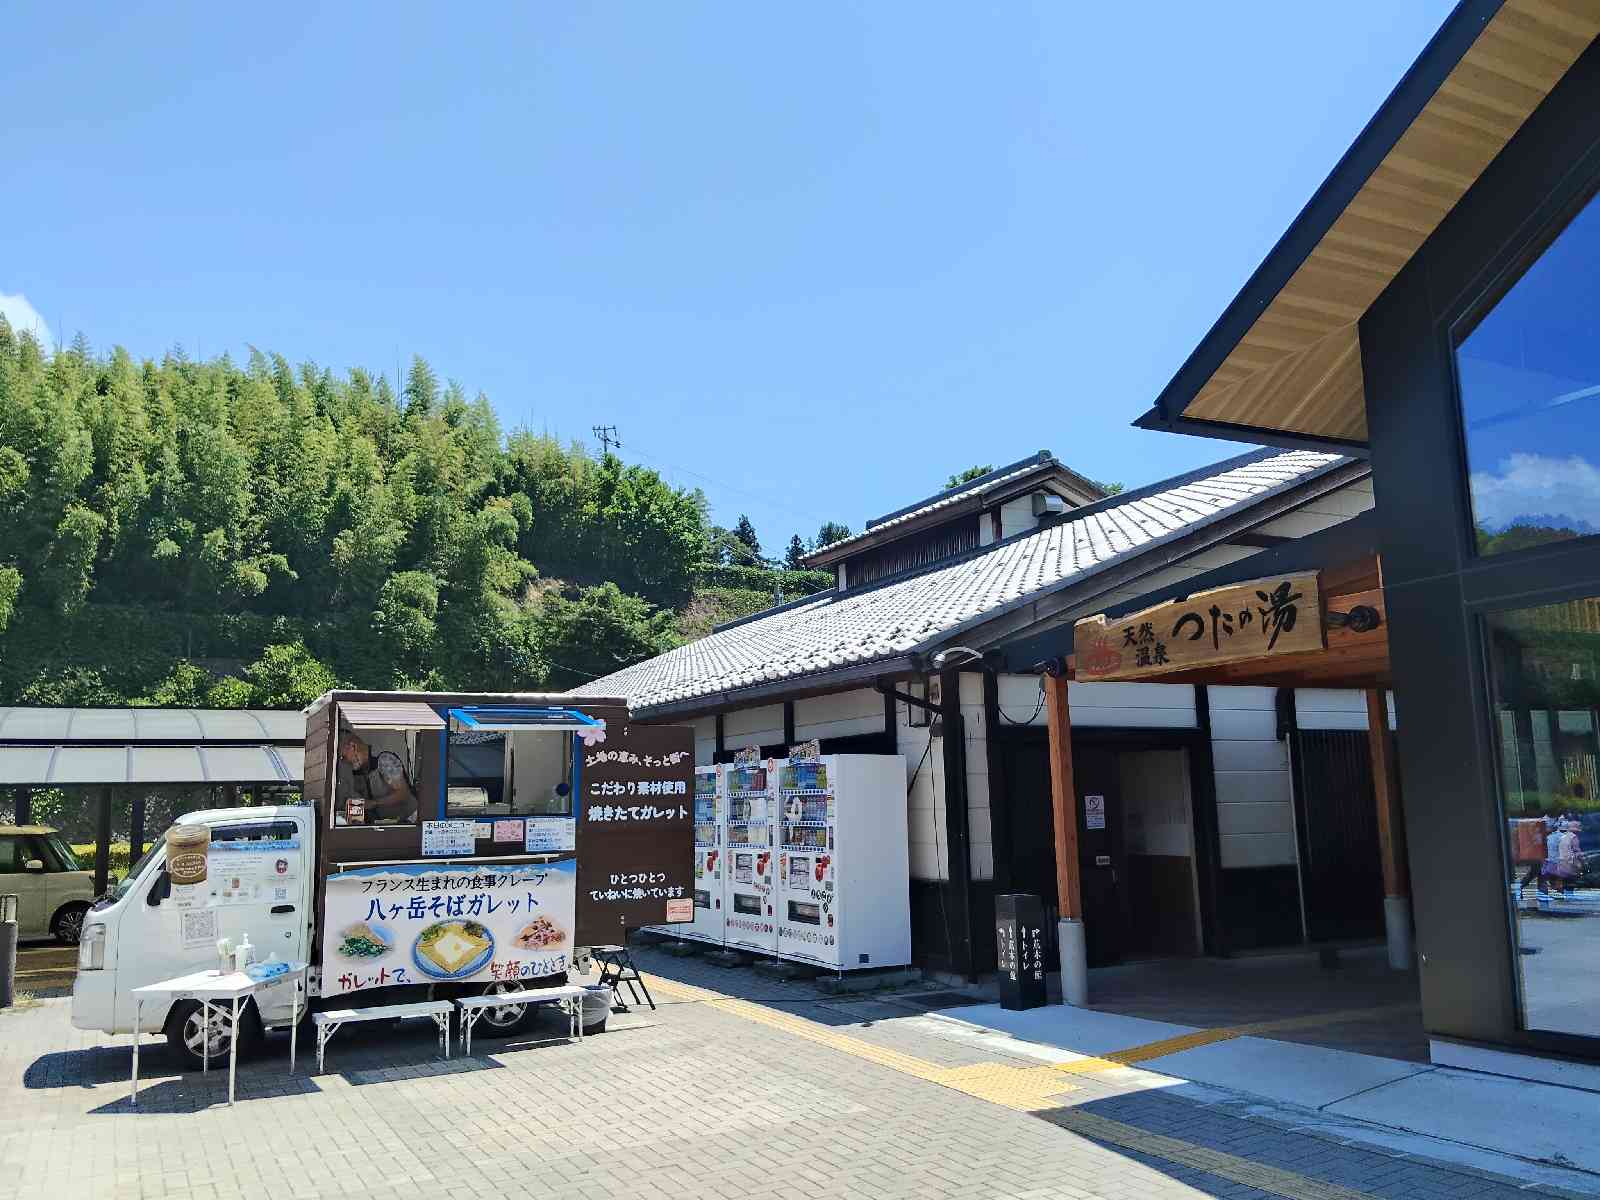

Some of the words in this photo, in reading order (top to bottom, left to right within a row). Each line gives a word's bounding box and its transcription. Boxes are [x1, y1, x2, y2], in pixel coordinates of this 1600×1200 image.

[1171, 581, 1303, 651] つたの湯
[1121, 622, 1155, 649] 天然
[1136, 640, 1171, 667] 温泉
[590, 780, 687, 796] こだわり素材使用
[588, 804, 688, 822] 焼きたてガレット
[360, 873, 549, 894] フランス生まれの食事クレープ
[609, 872, 667, 885] ひとつひとつ
[589, 886, 685, 901] ていねいに焼いています
[365, 892, 540, 922] 八ヶ岳そばガレット
[489, 955, 567, 981] 笑顔のひととき
[1022, 940, 1030, 971] トイレ
